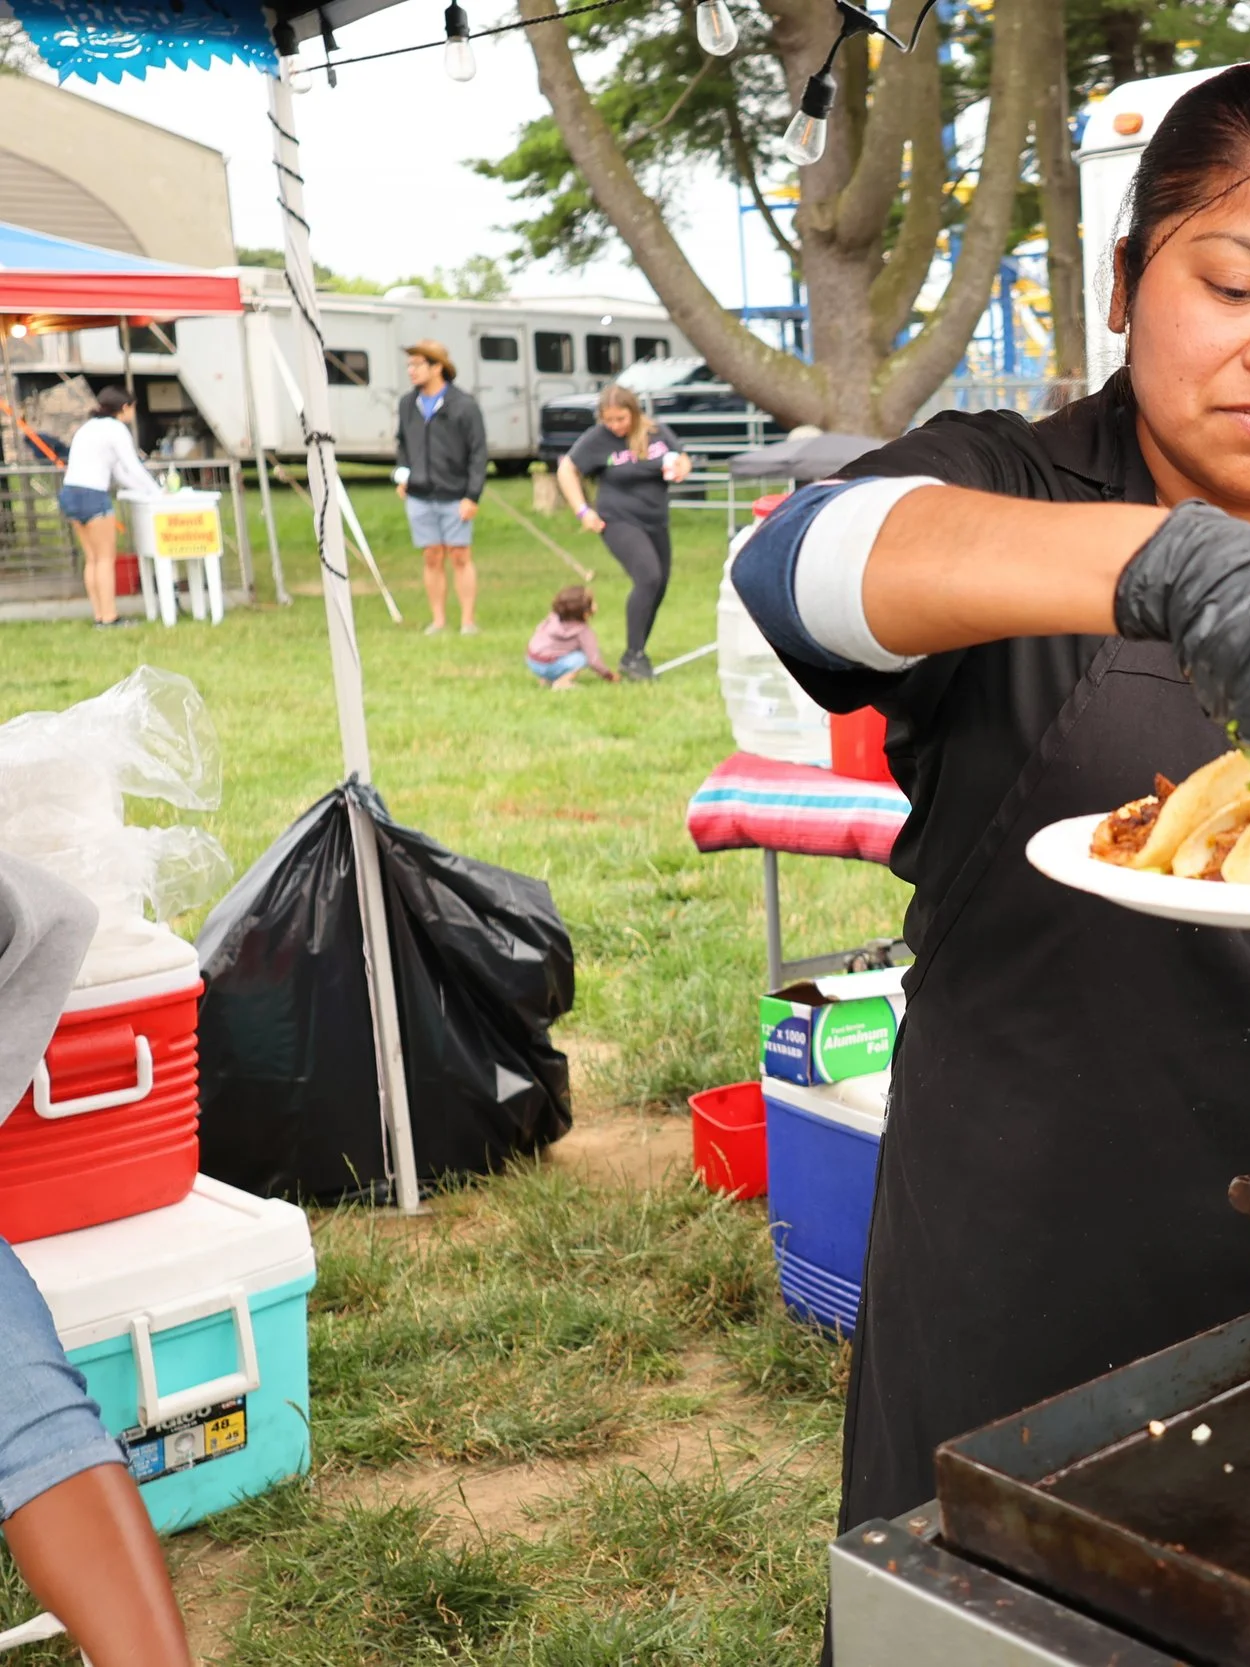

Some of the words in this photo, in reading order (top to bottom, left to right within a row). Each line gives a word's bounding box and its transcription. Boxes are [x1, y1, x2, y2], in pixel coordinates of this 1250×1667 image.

[785, 1029, 807, 1046] 1000
[824, 1028, 888, 1050] Aluminum
[765, 1041, 802, 1058] STANDARD
[867, 1039, 888, 1054] Foil
[211, 1417, 230, 1433] 48
